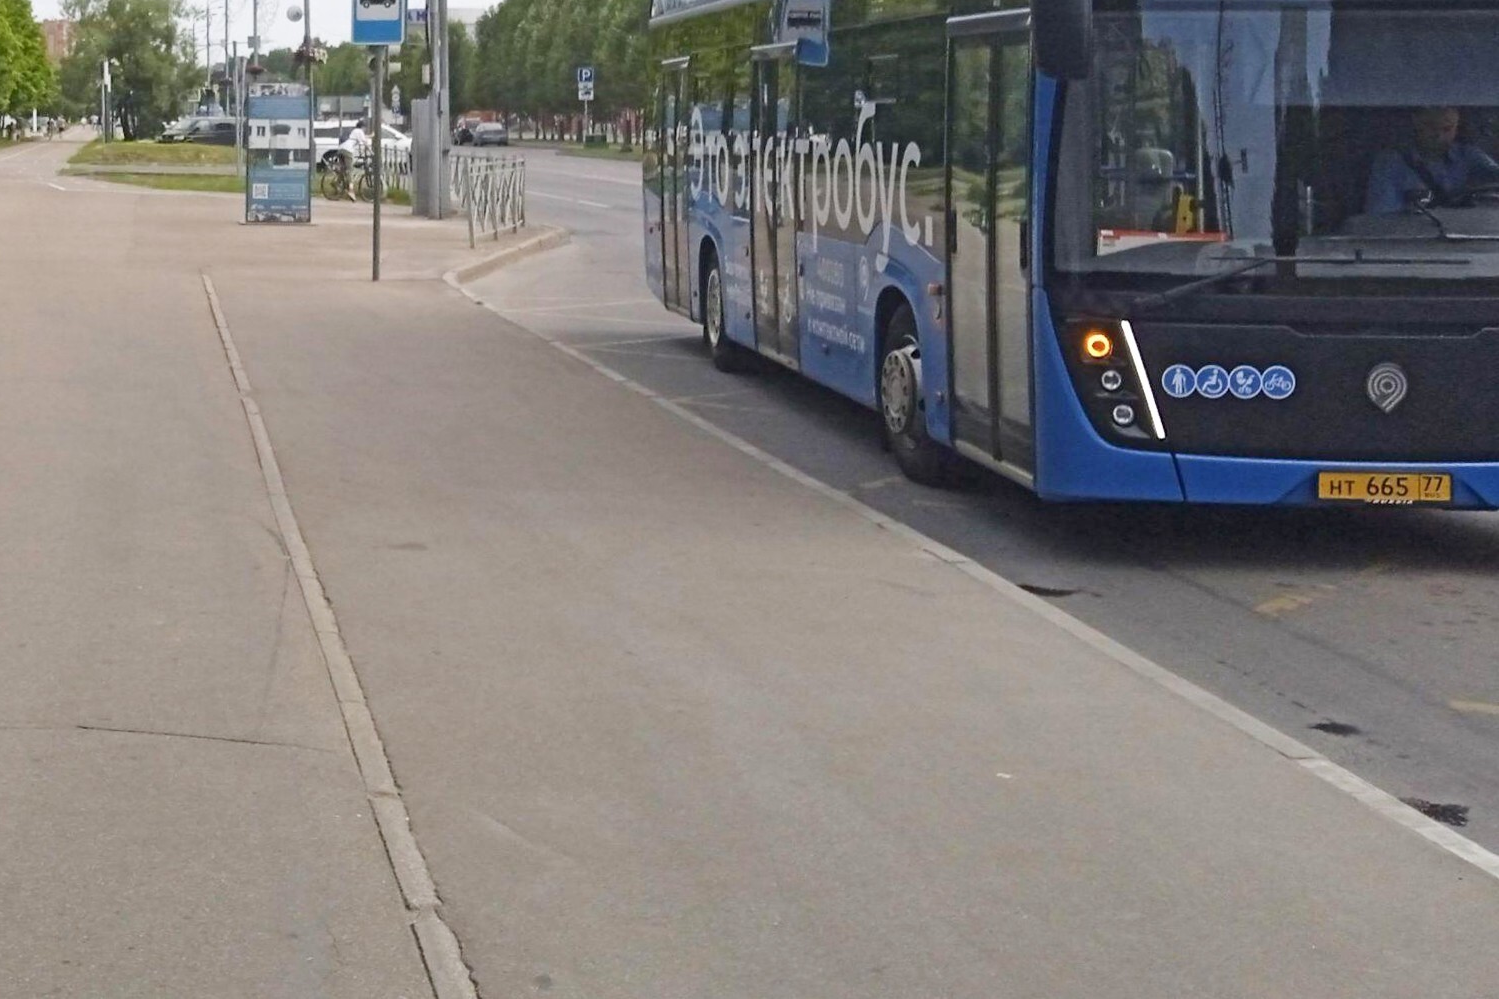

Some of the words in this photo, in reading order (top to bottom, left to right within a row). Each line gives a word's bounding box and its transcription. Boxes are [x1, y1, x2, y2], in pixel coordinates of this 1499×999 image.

[689, 105, 730, 207] Это
[734, 101, 934, 273] электробус.
[1367, 476, 1409, 496] 665
[1422, 475, 1443, 492] 77
